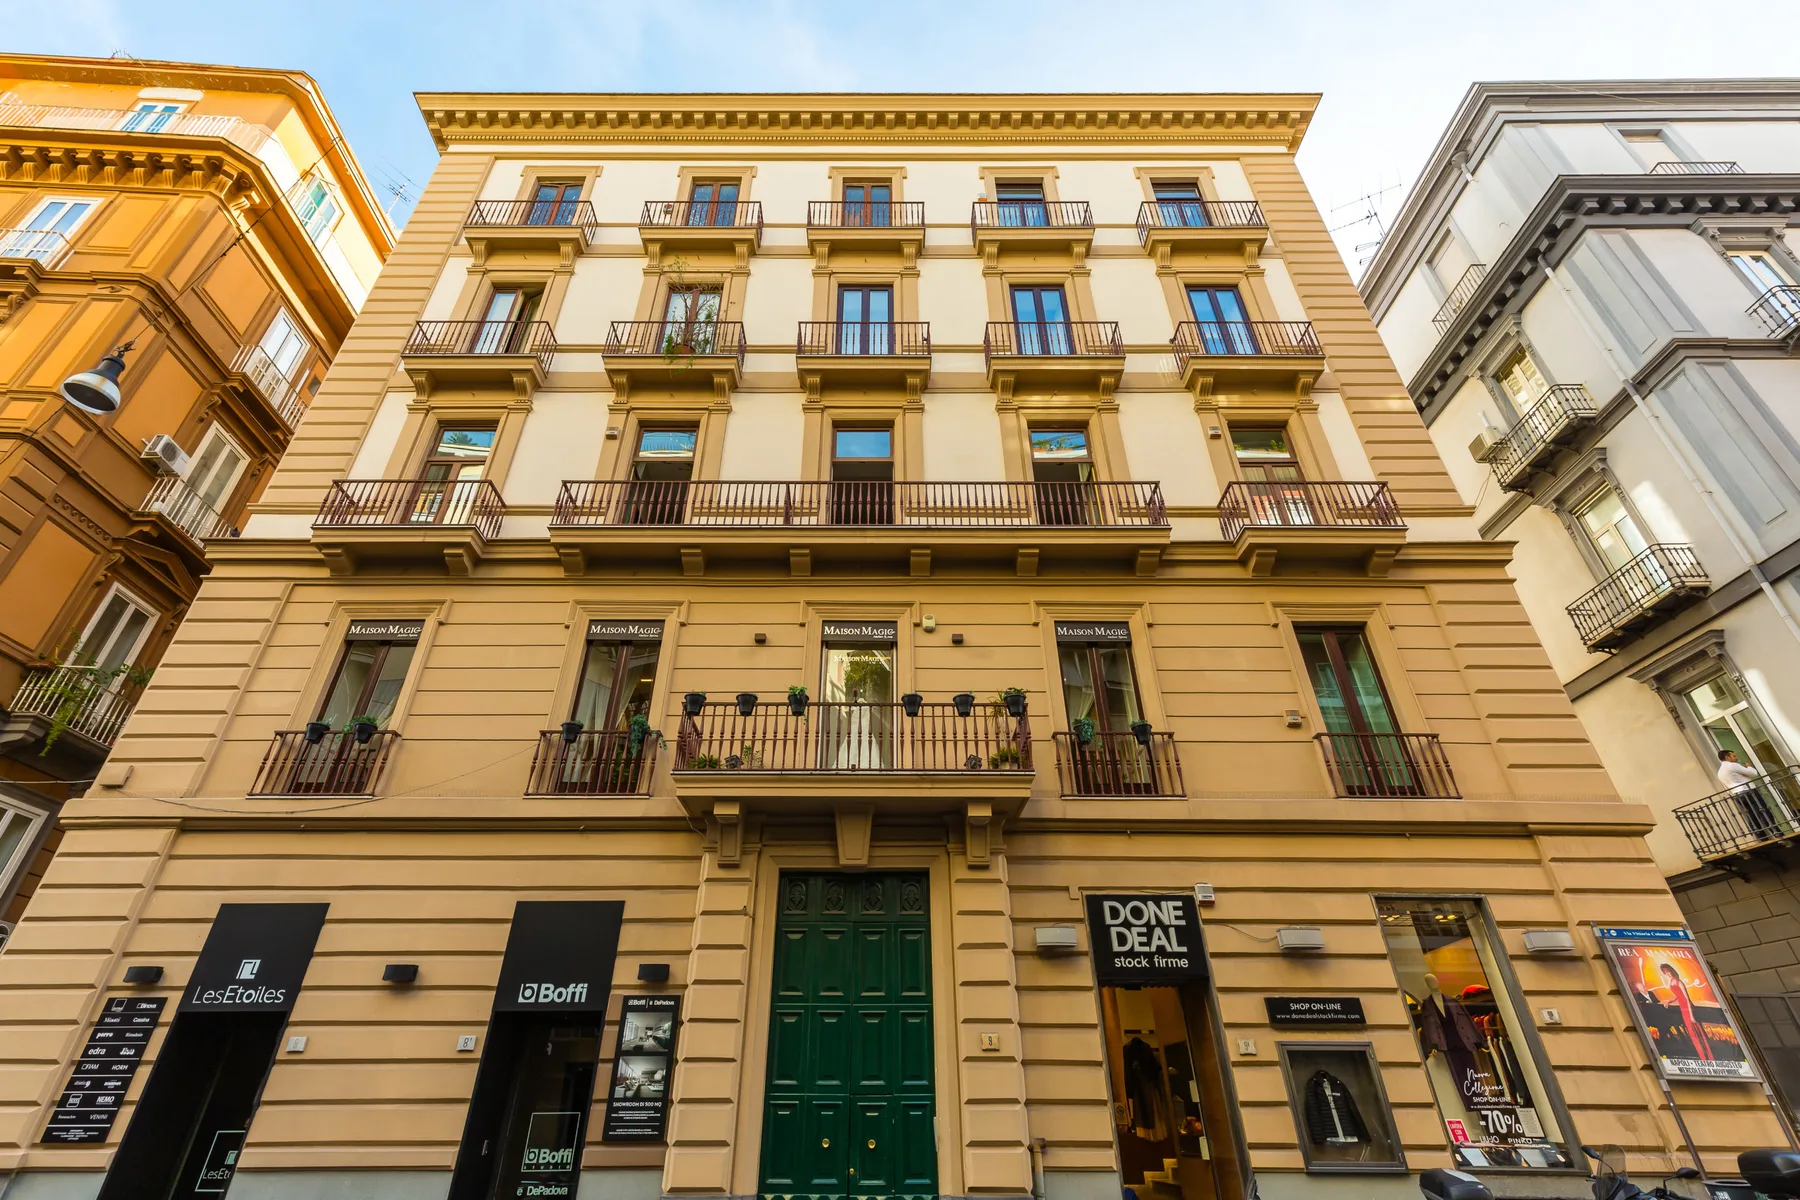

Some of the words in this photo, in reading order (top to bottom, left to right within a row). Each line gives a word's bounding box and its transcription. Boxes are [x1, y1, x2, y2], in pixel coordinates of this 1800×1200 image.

[349, 625, 387, 634] MAISON
[590, 625, 627, 634] MAISON
[824, 626, 860, 634] MAISON
[1057, 627, 1093, 635] MAISON
[1103, 900, 1186, 926] DONE
[1110, 926, 1188, 952] DEAL
[1618, 948, 1639, 957] REA
[1114, 955, 1150, 968] stock
[1154, 954, 1189, 968] firme
[192, 985, 286, 1004] LesEtoiles
[538, 983, 588, 1003] Boffi
[1479, 1110, 1523, 1134] -70%
[539, 1148, 572, 1163] Boffi
[527, 1186, 568, 1196] DePadova
